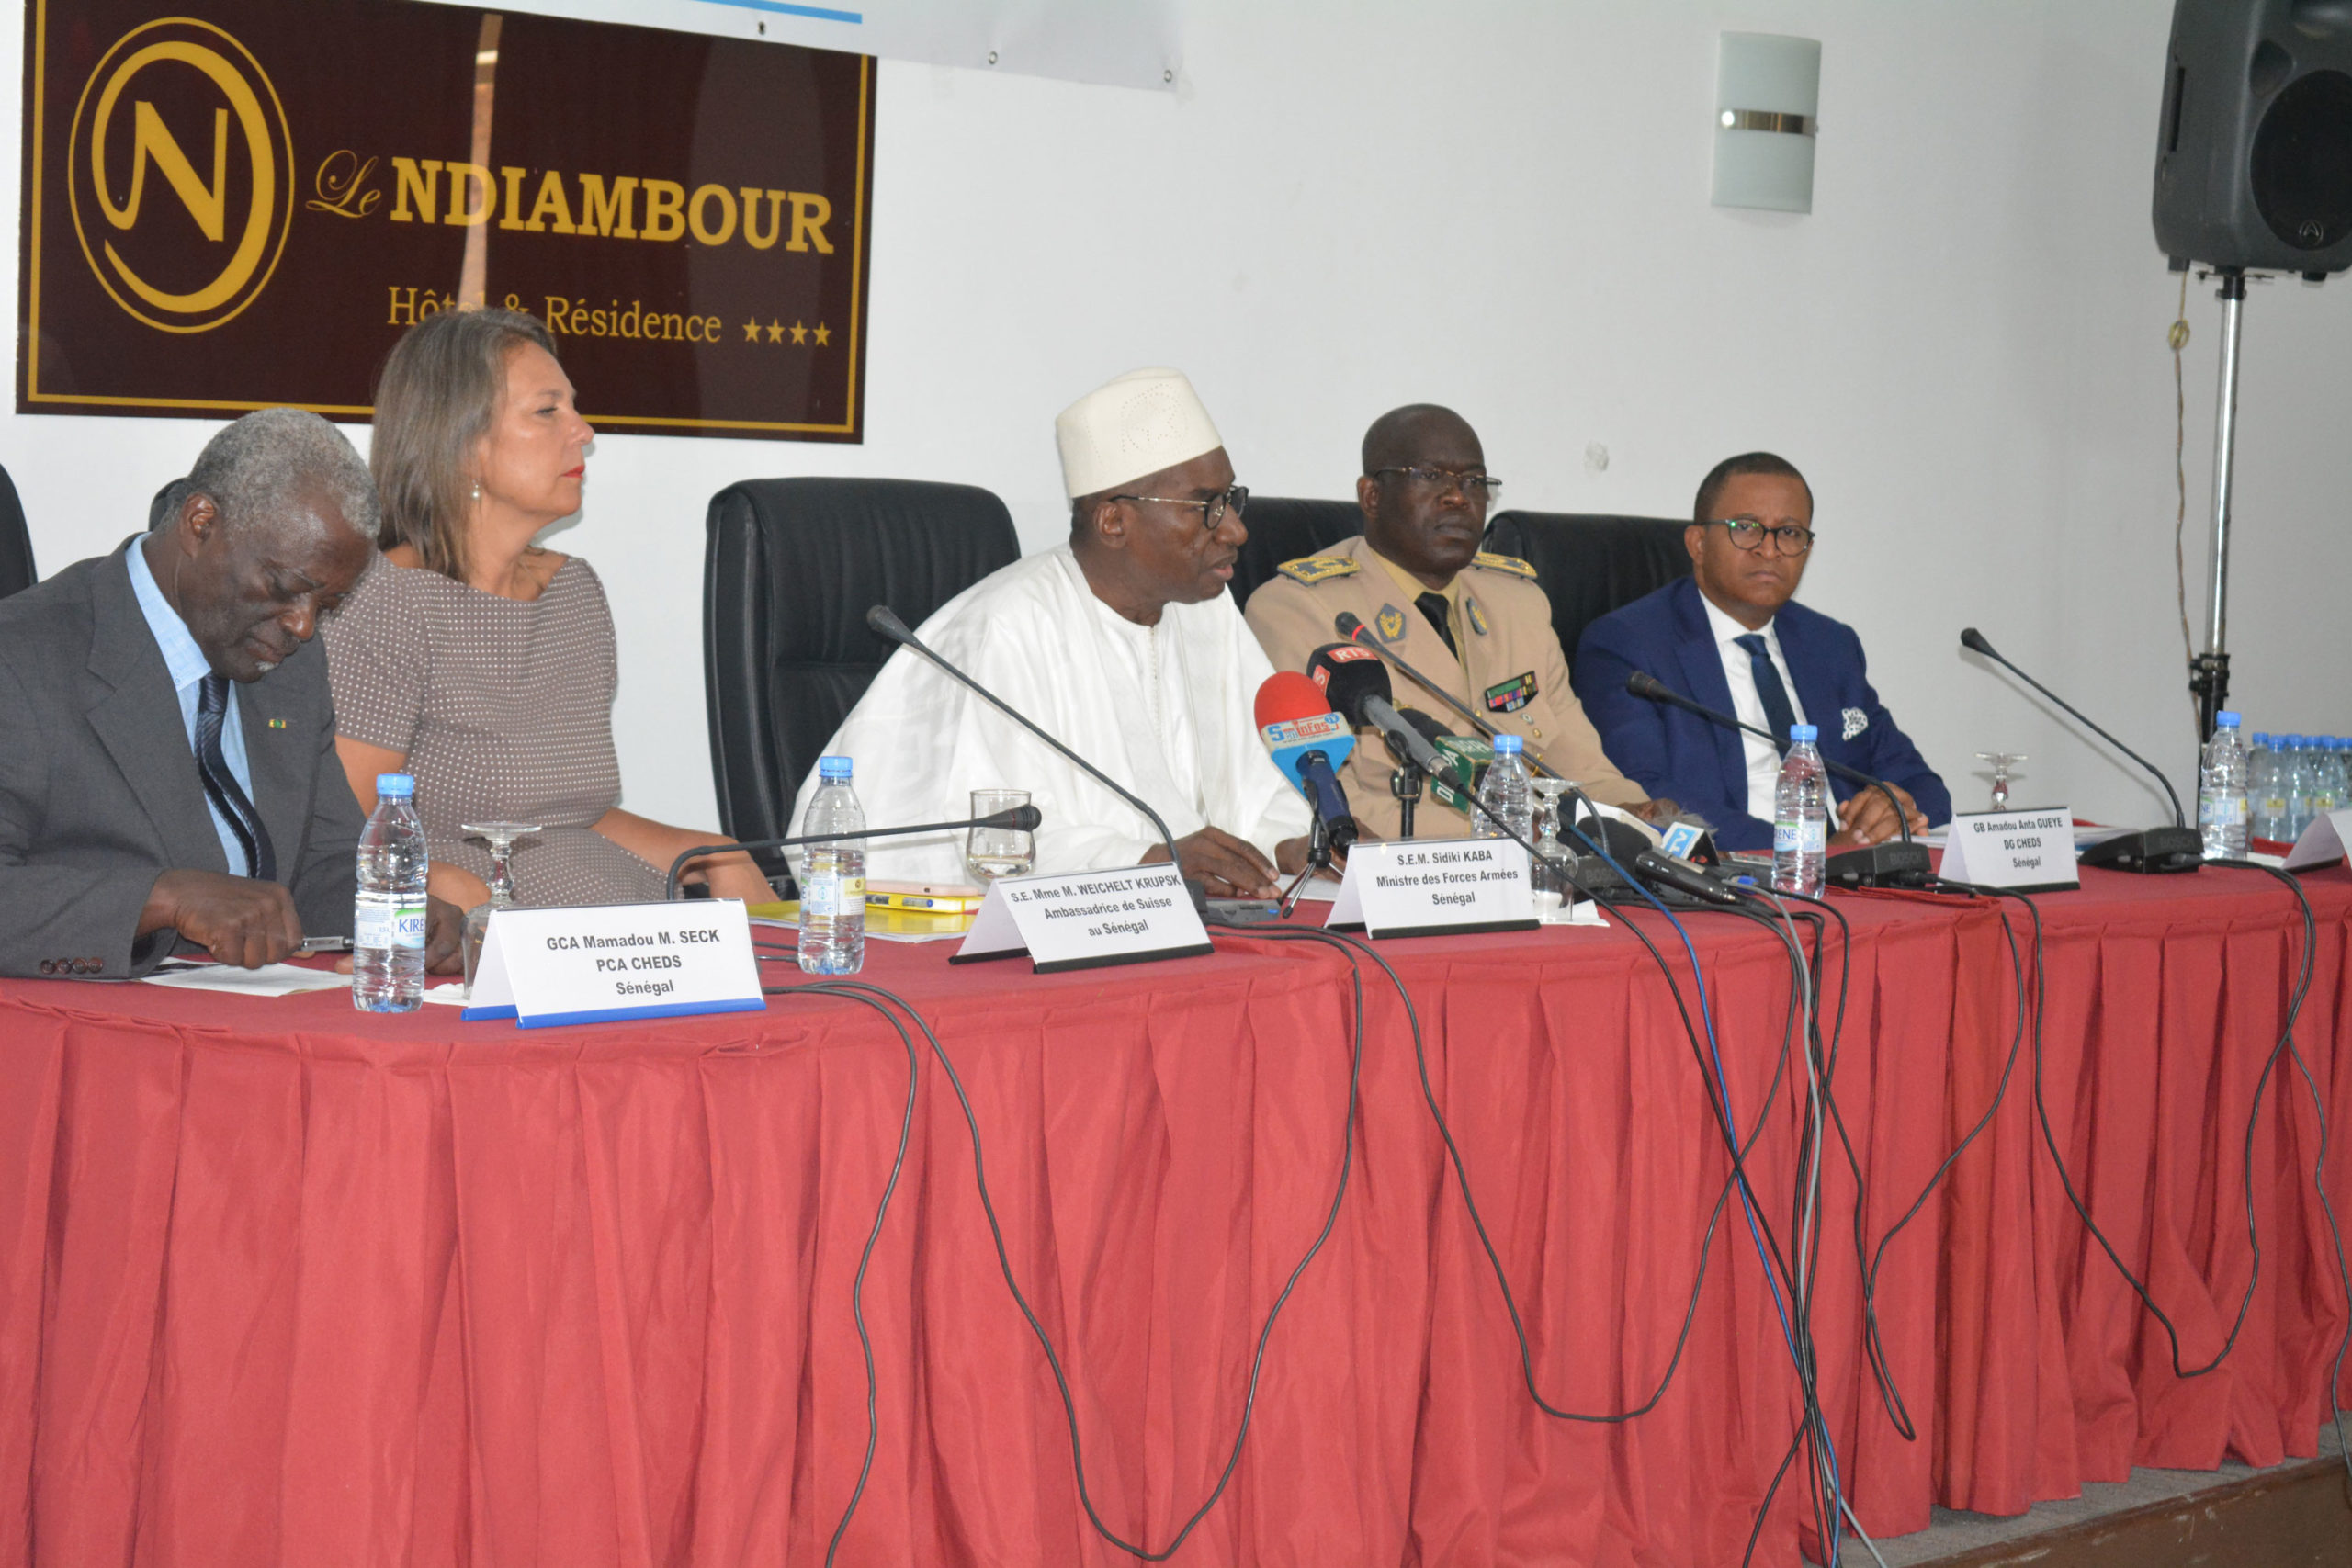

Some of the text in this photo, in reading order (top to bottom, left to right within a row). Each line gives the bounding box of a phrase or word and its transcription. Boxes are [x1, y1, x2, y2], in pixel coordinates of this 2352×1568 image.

[306, 149, 834, 254] Le NDIAMBOUR
[545, 295, 722, 343] Résidence
[1973, 817, 2063, 833] GB Amadou Anta GUEYE
[2004, 837, 2041, 850] DG CHEDS
[1397, 850, 1493, 866] S.E.M. Sidiki KABA
[2013, 856, 2041, 869] Sénégal
[1376, 869, 1518, 887] Ministre des Forces Armées
[1011, 874, 1182, 902] S.E. Mme M. WEICHELT KRUPSK
[1431, 891, 1476, 907] Sénégal
[1044, 897, 1173, 919] Ambassadrice de Suisse
[1088, 919, 1149, 936] au Sénégal
[547, 929, 720, 950] GCA Mamadou M. SECK
[596, 955, 682, 972] PCA CHEDS
[616, 979, 674, 996] Sénégal
